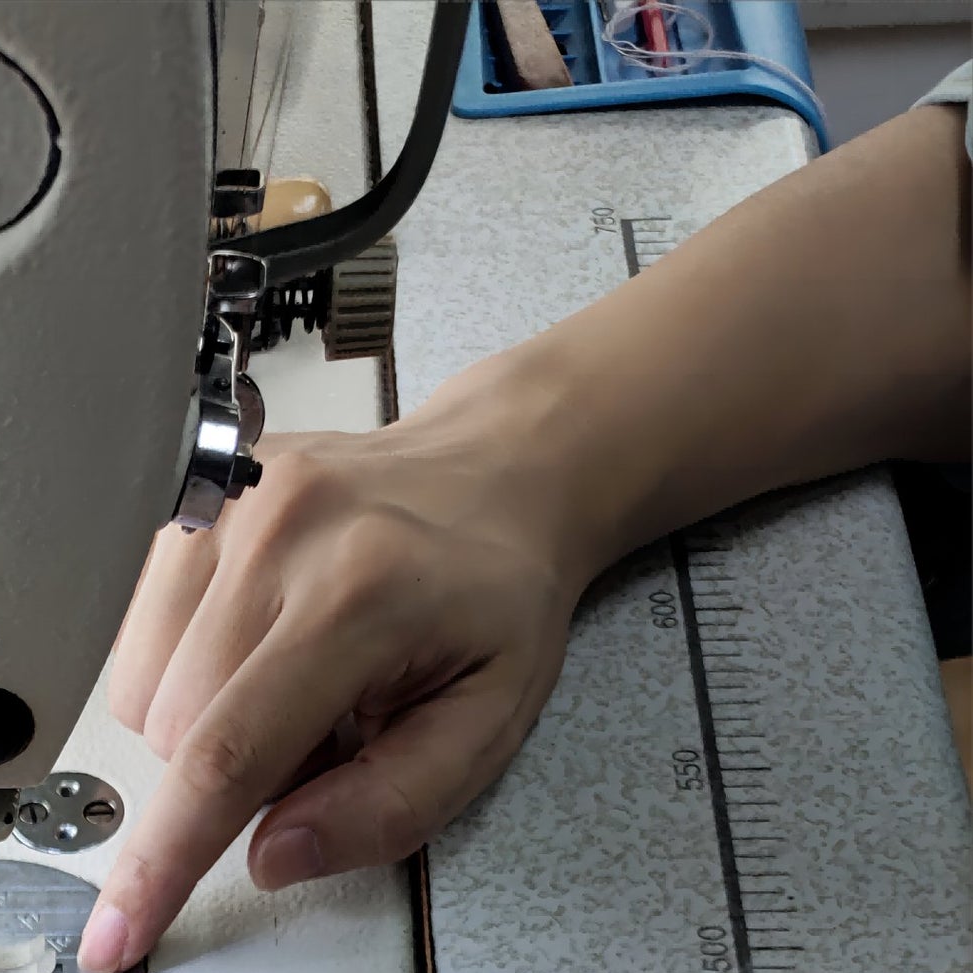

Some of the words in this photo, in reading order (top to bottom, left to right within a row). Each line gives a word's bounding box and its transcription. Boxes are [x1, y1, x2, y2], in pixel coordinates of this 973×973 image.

[649, 590, 678, 629] 600
[672, 749, 704, 790] 550
[697, 925, 731, 973] 500
